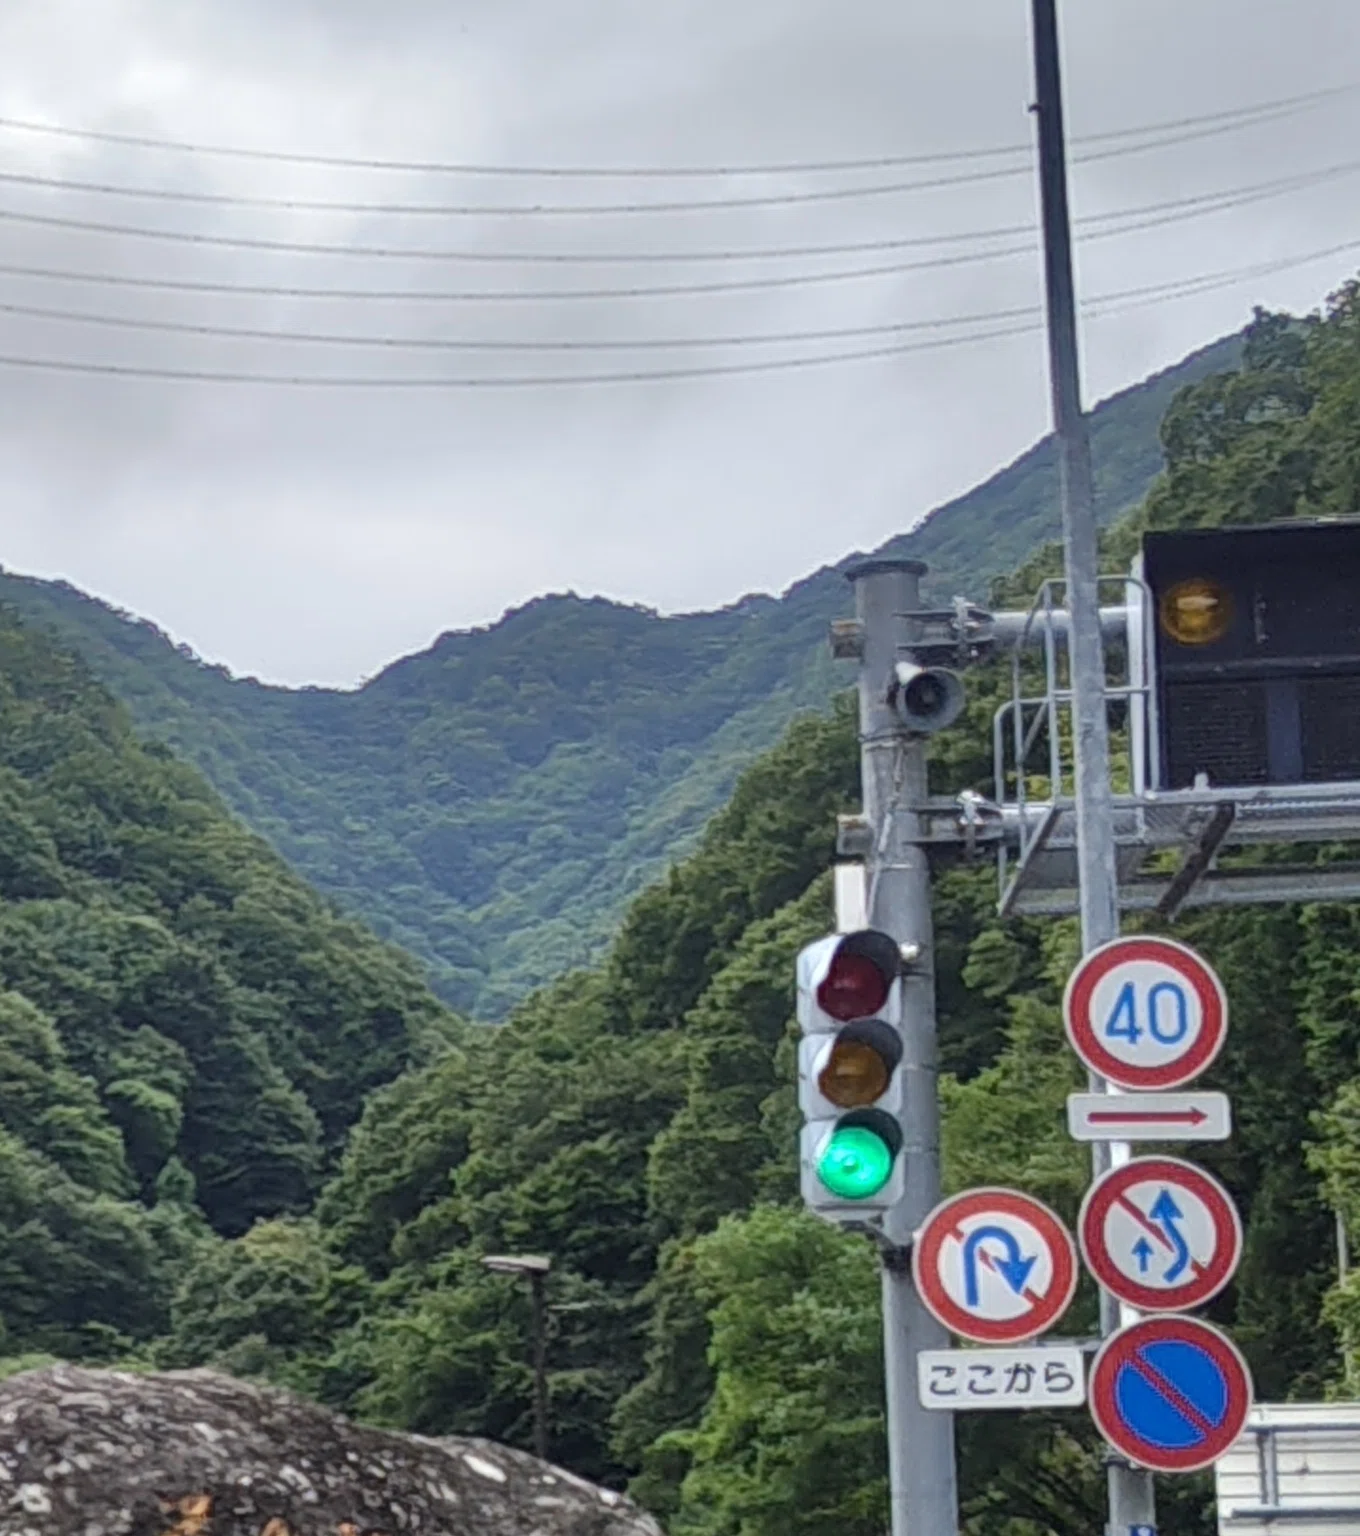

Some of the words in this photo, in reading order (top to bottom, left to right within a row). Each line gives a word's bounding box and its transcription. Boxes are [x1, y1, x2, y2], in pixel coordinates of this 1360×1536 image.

[1105, 981, 1187, 1044] 40
[930, 1362, 1074, 1395] ここから
